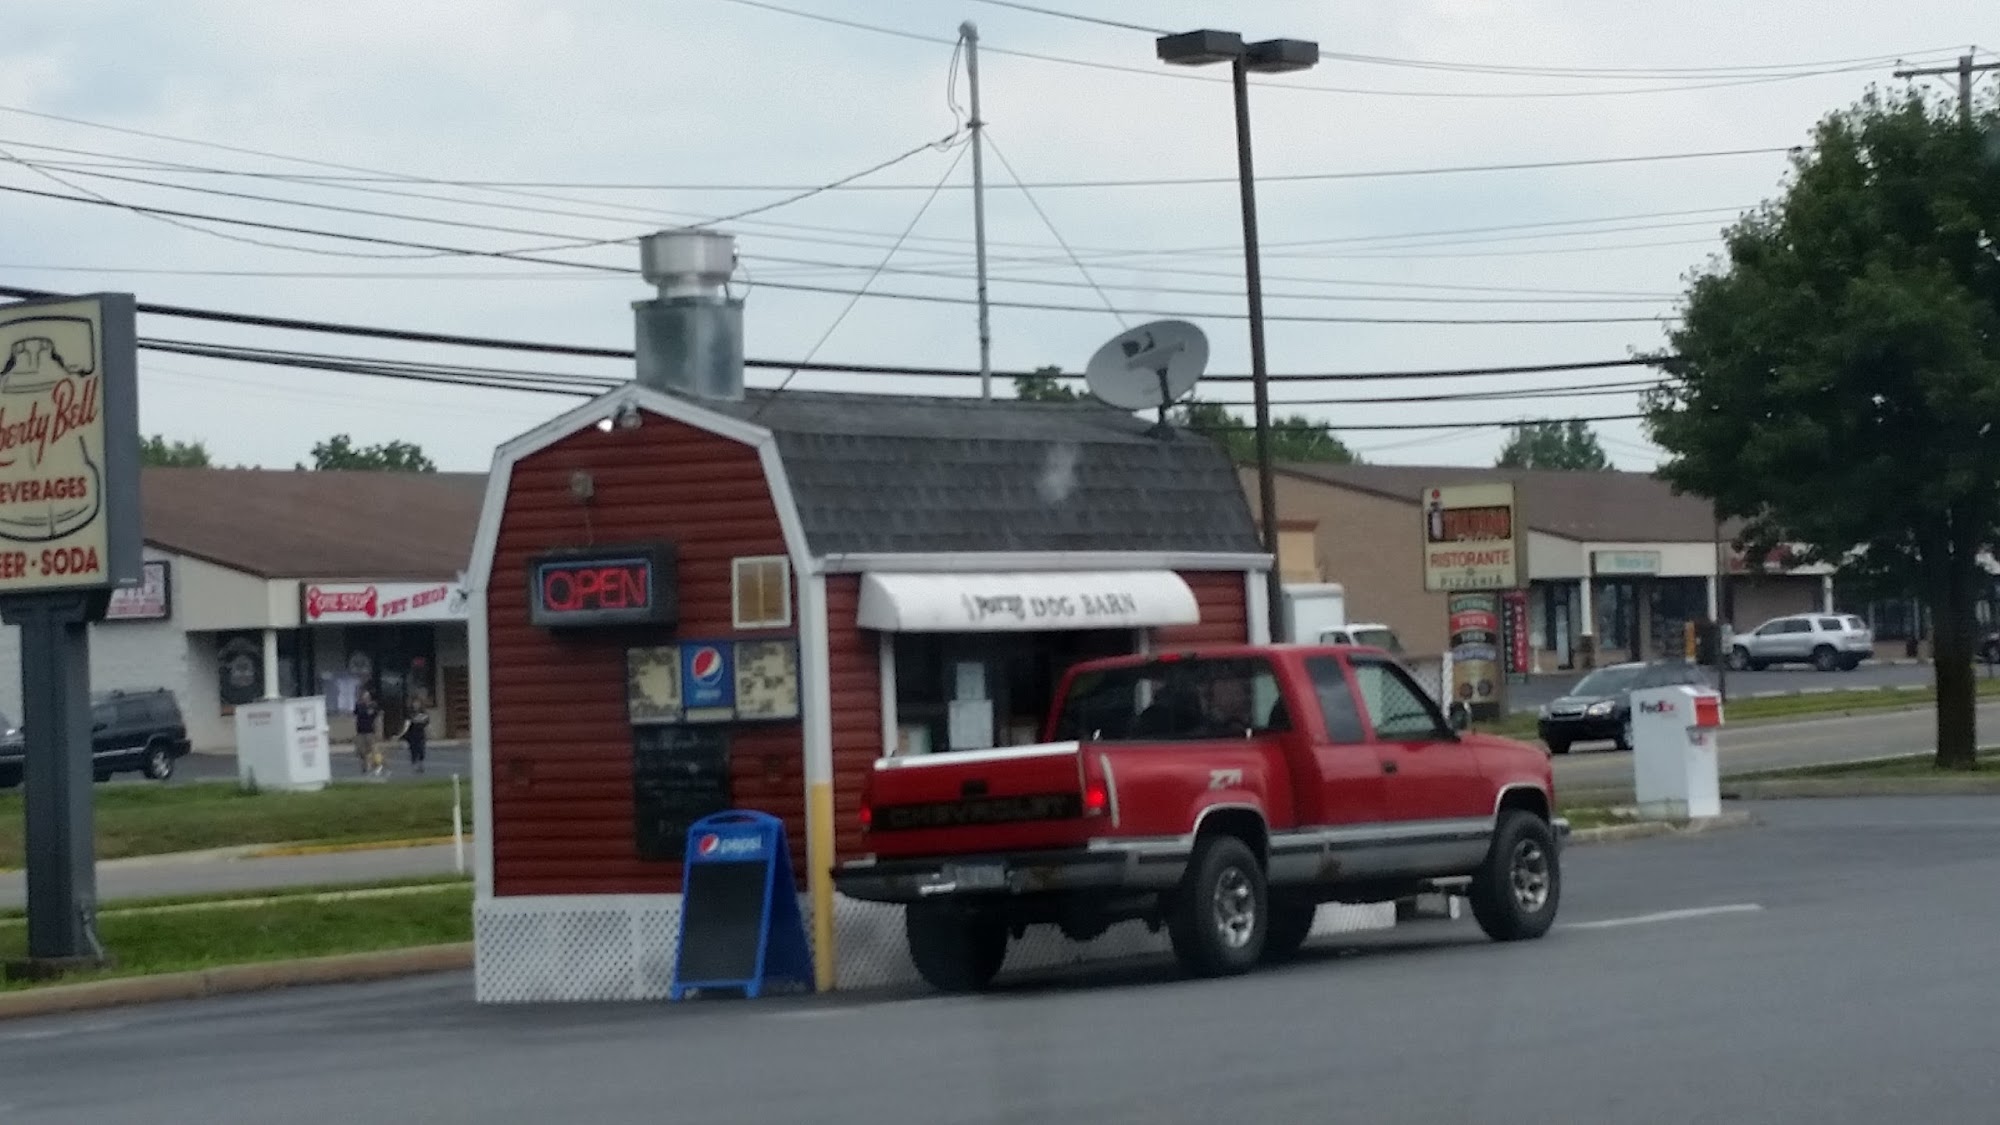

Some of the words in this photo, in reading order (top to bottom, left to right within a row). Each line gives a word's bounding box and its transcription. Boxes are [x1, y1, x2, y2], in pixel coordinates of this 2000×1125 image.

[51, 376, 98, 444] Bell
[41, 547, 99, 576] SODA
[1430, 550, 1510, 569] RISTORANTE
[544, 567, 647, 611] OPEN
[1440, 574, 1503, 588] PIZZERIA
[381, 597, 407, 618] PET
[412, 585, 448, 609] SHOP
[1030, 596, 1075, 617] DOG
[1080, 593, 1138, 615] BARN
[1640, 701, 1674, 713] FedEx
[1210, 769, 1242, 789] Z71
